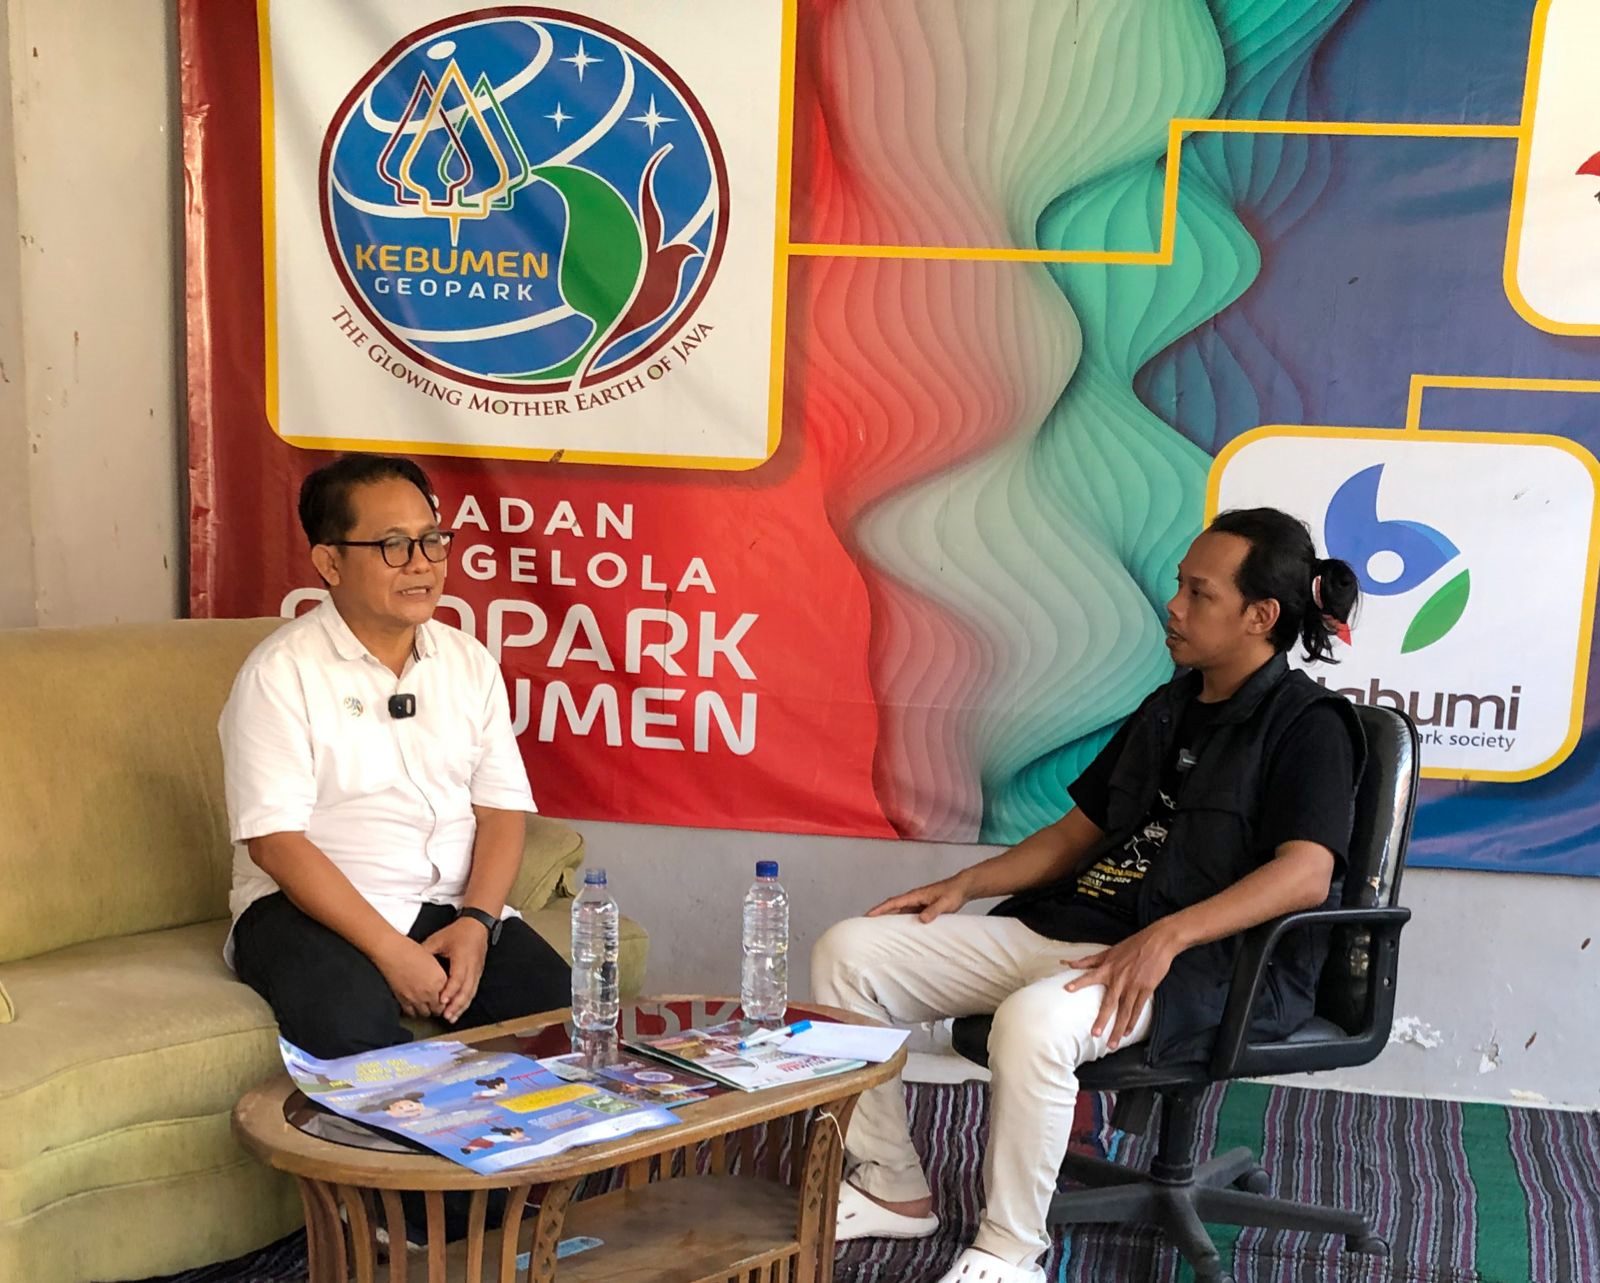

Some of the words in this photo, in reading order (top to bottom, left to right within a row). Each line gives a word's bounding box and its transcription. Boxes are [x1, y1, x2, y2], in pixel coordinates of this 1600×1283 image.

[355, 243, 549, 279] KEBUMEN
[374, 276, 533, 301] GEOPARK
[332, 305, 368, 348] THE
[368, 344, 463, 407] GLOWING
[468, 393, 571, 417] MOTHER
[574, 375, 645, 411] EARTH
[646, 355, 673, 381] OF
[671, 323, 714, 364] JAVA
[440, 535, 717, 594] GELOLA
[280, 587, 759, 681] PARK
[1449, 734, 1516, 752] society
